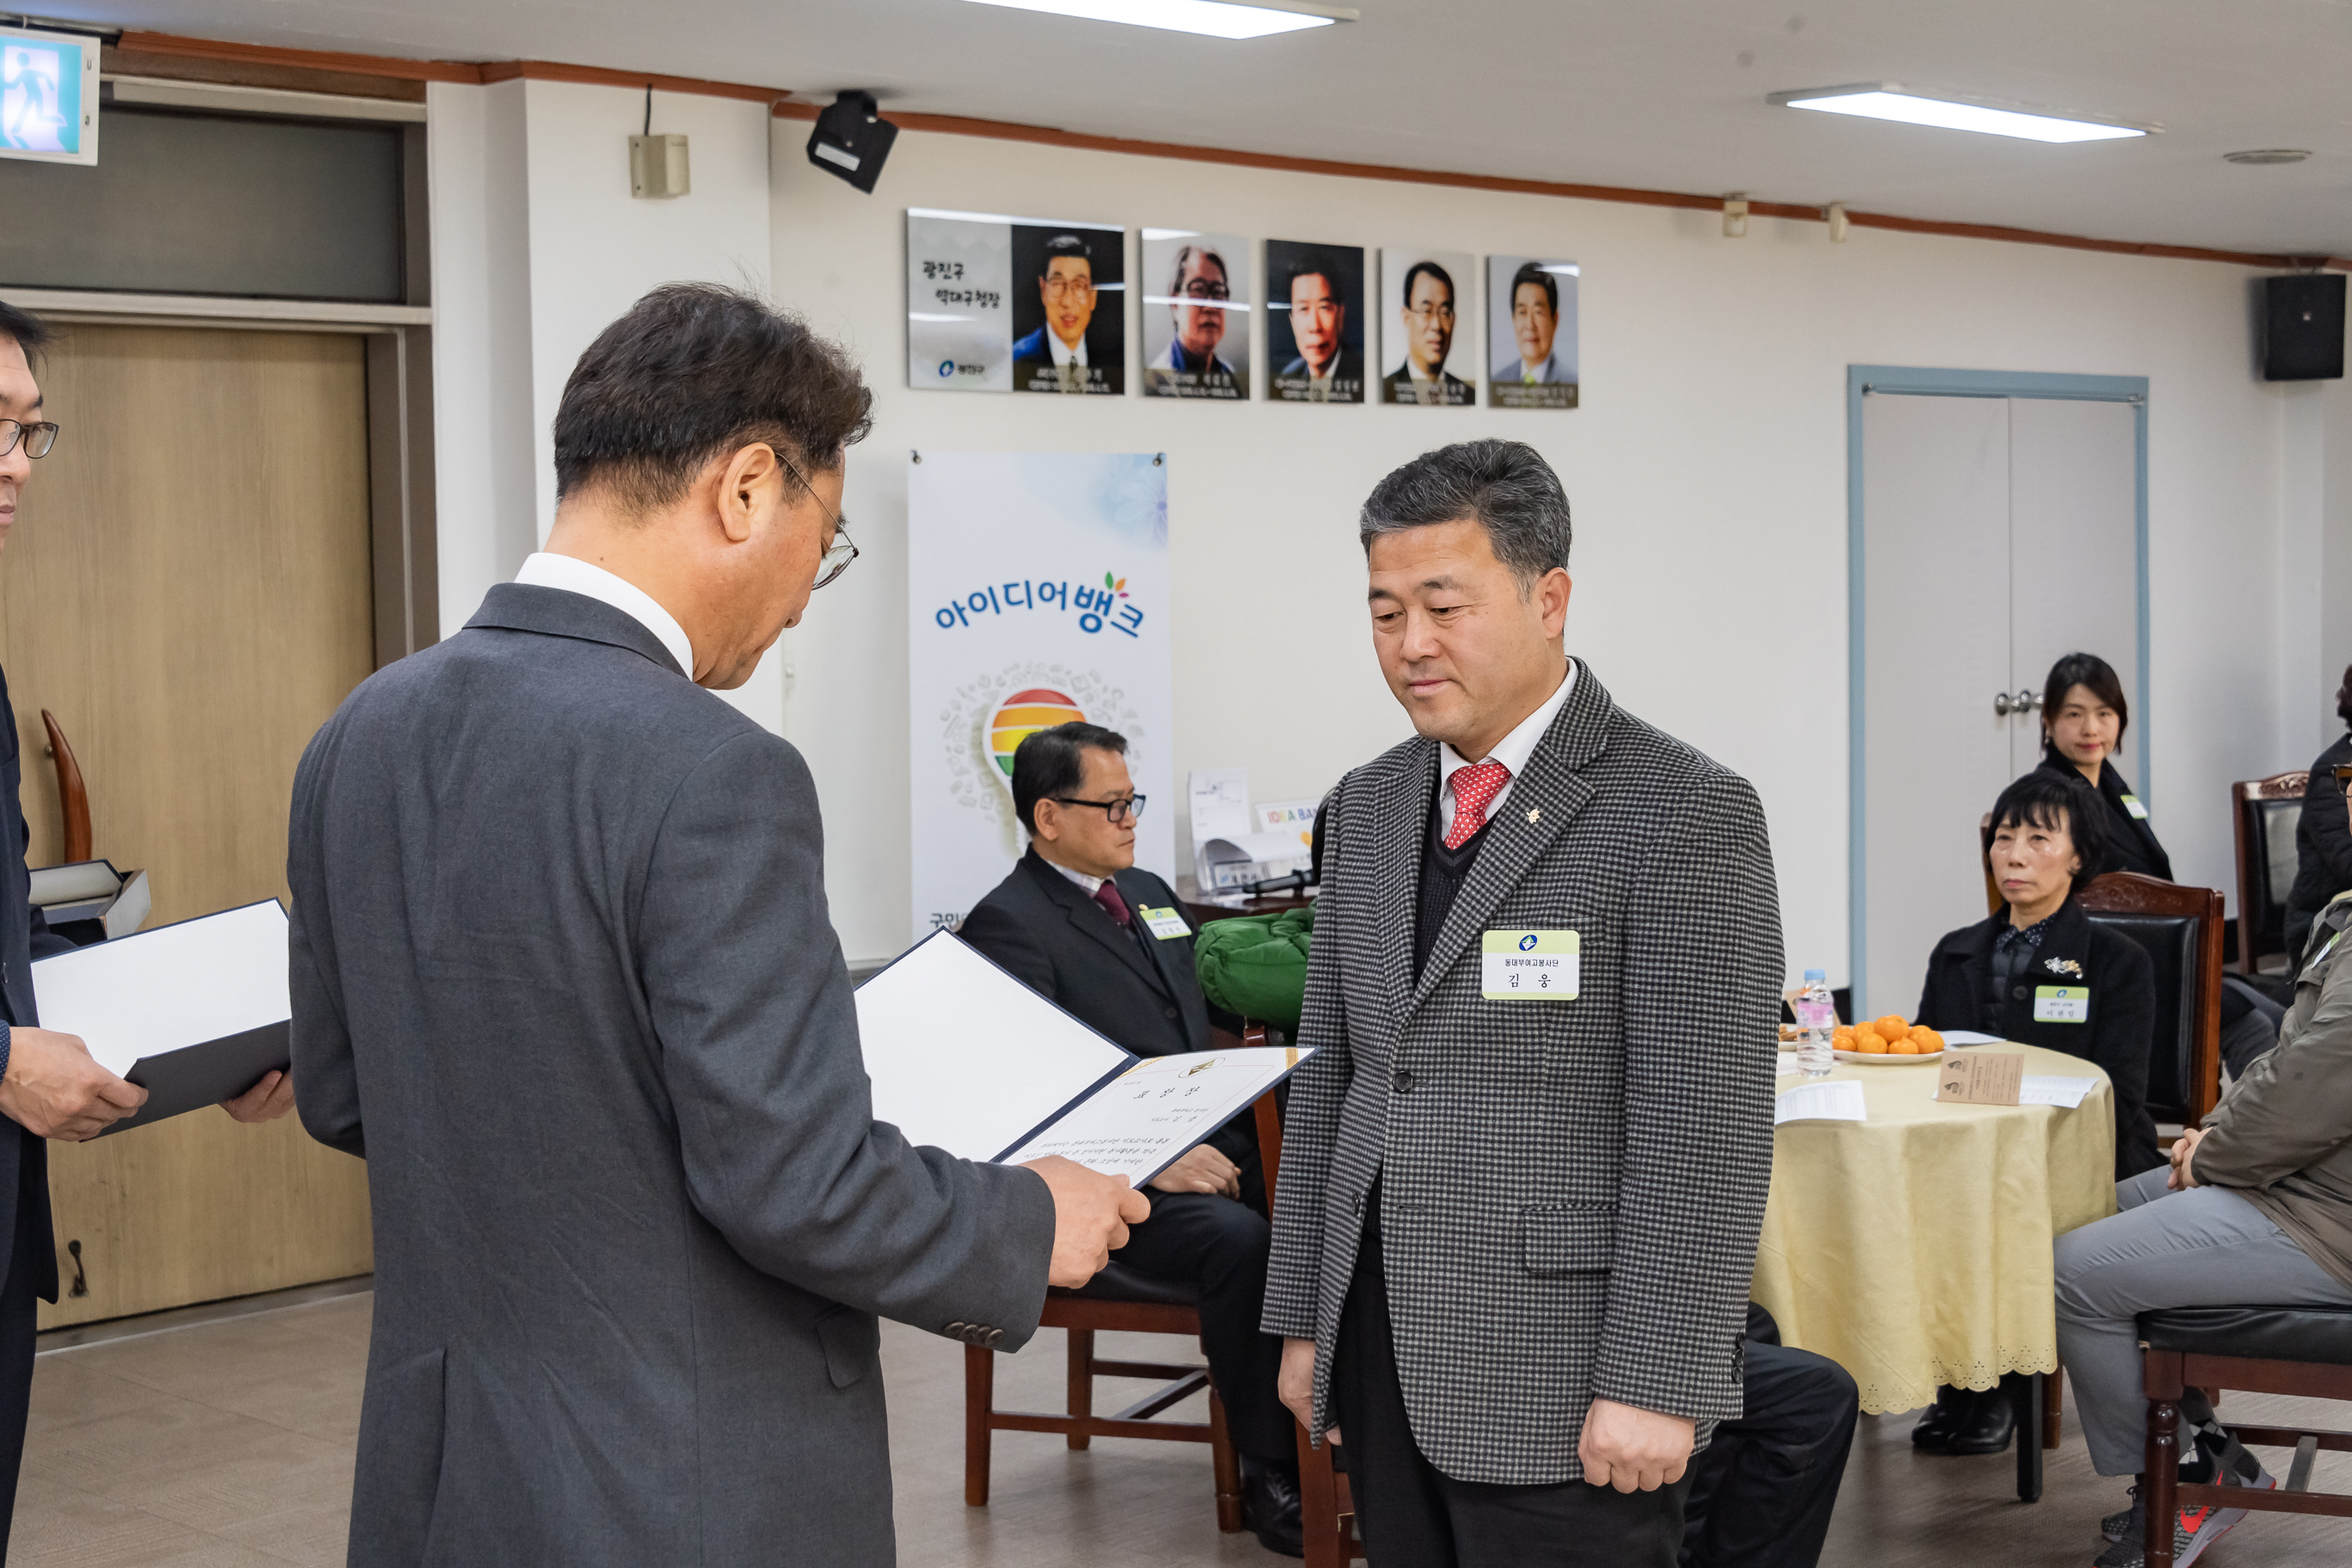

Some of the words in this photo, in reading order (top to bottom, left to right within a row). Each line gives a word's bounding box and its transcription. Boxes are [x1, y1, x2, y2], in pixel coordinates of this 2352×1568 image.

[923, 260, 964, 281] 광진구
[935, 579, 1144, 638] 아이디어뱅크
[1505, 959, 1559, 968] 동대부여고봉사단
